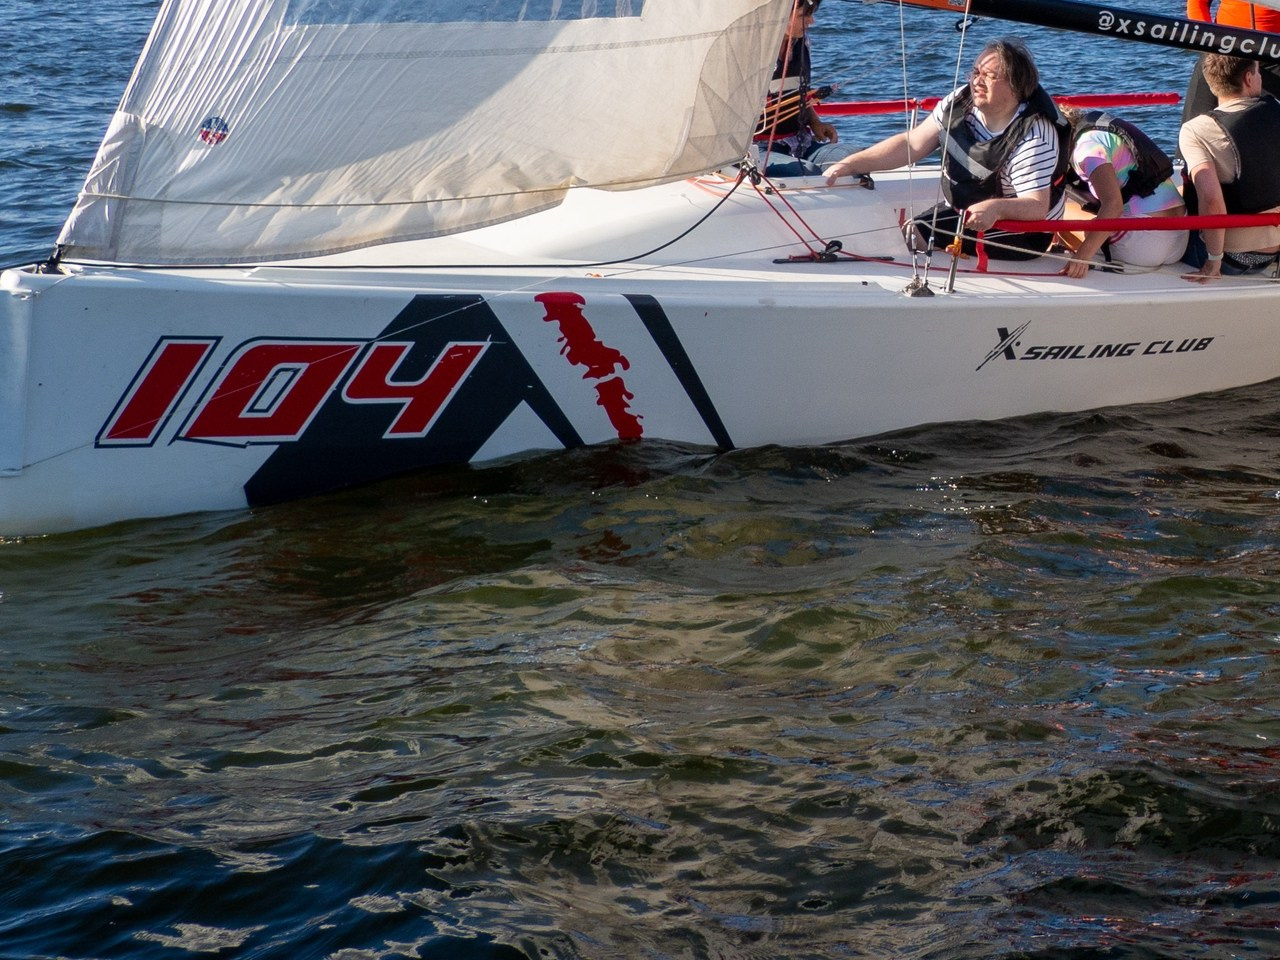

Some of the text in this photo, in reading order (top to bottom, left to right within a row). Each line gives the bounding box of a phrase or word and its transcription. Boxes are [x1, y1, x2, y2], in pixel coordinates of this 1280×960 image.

[1019, 342, 1141, 360] SAILING
[1142, 337, 1215, 355] CLUB
[95, 335, 492, 447] 104
